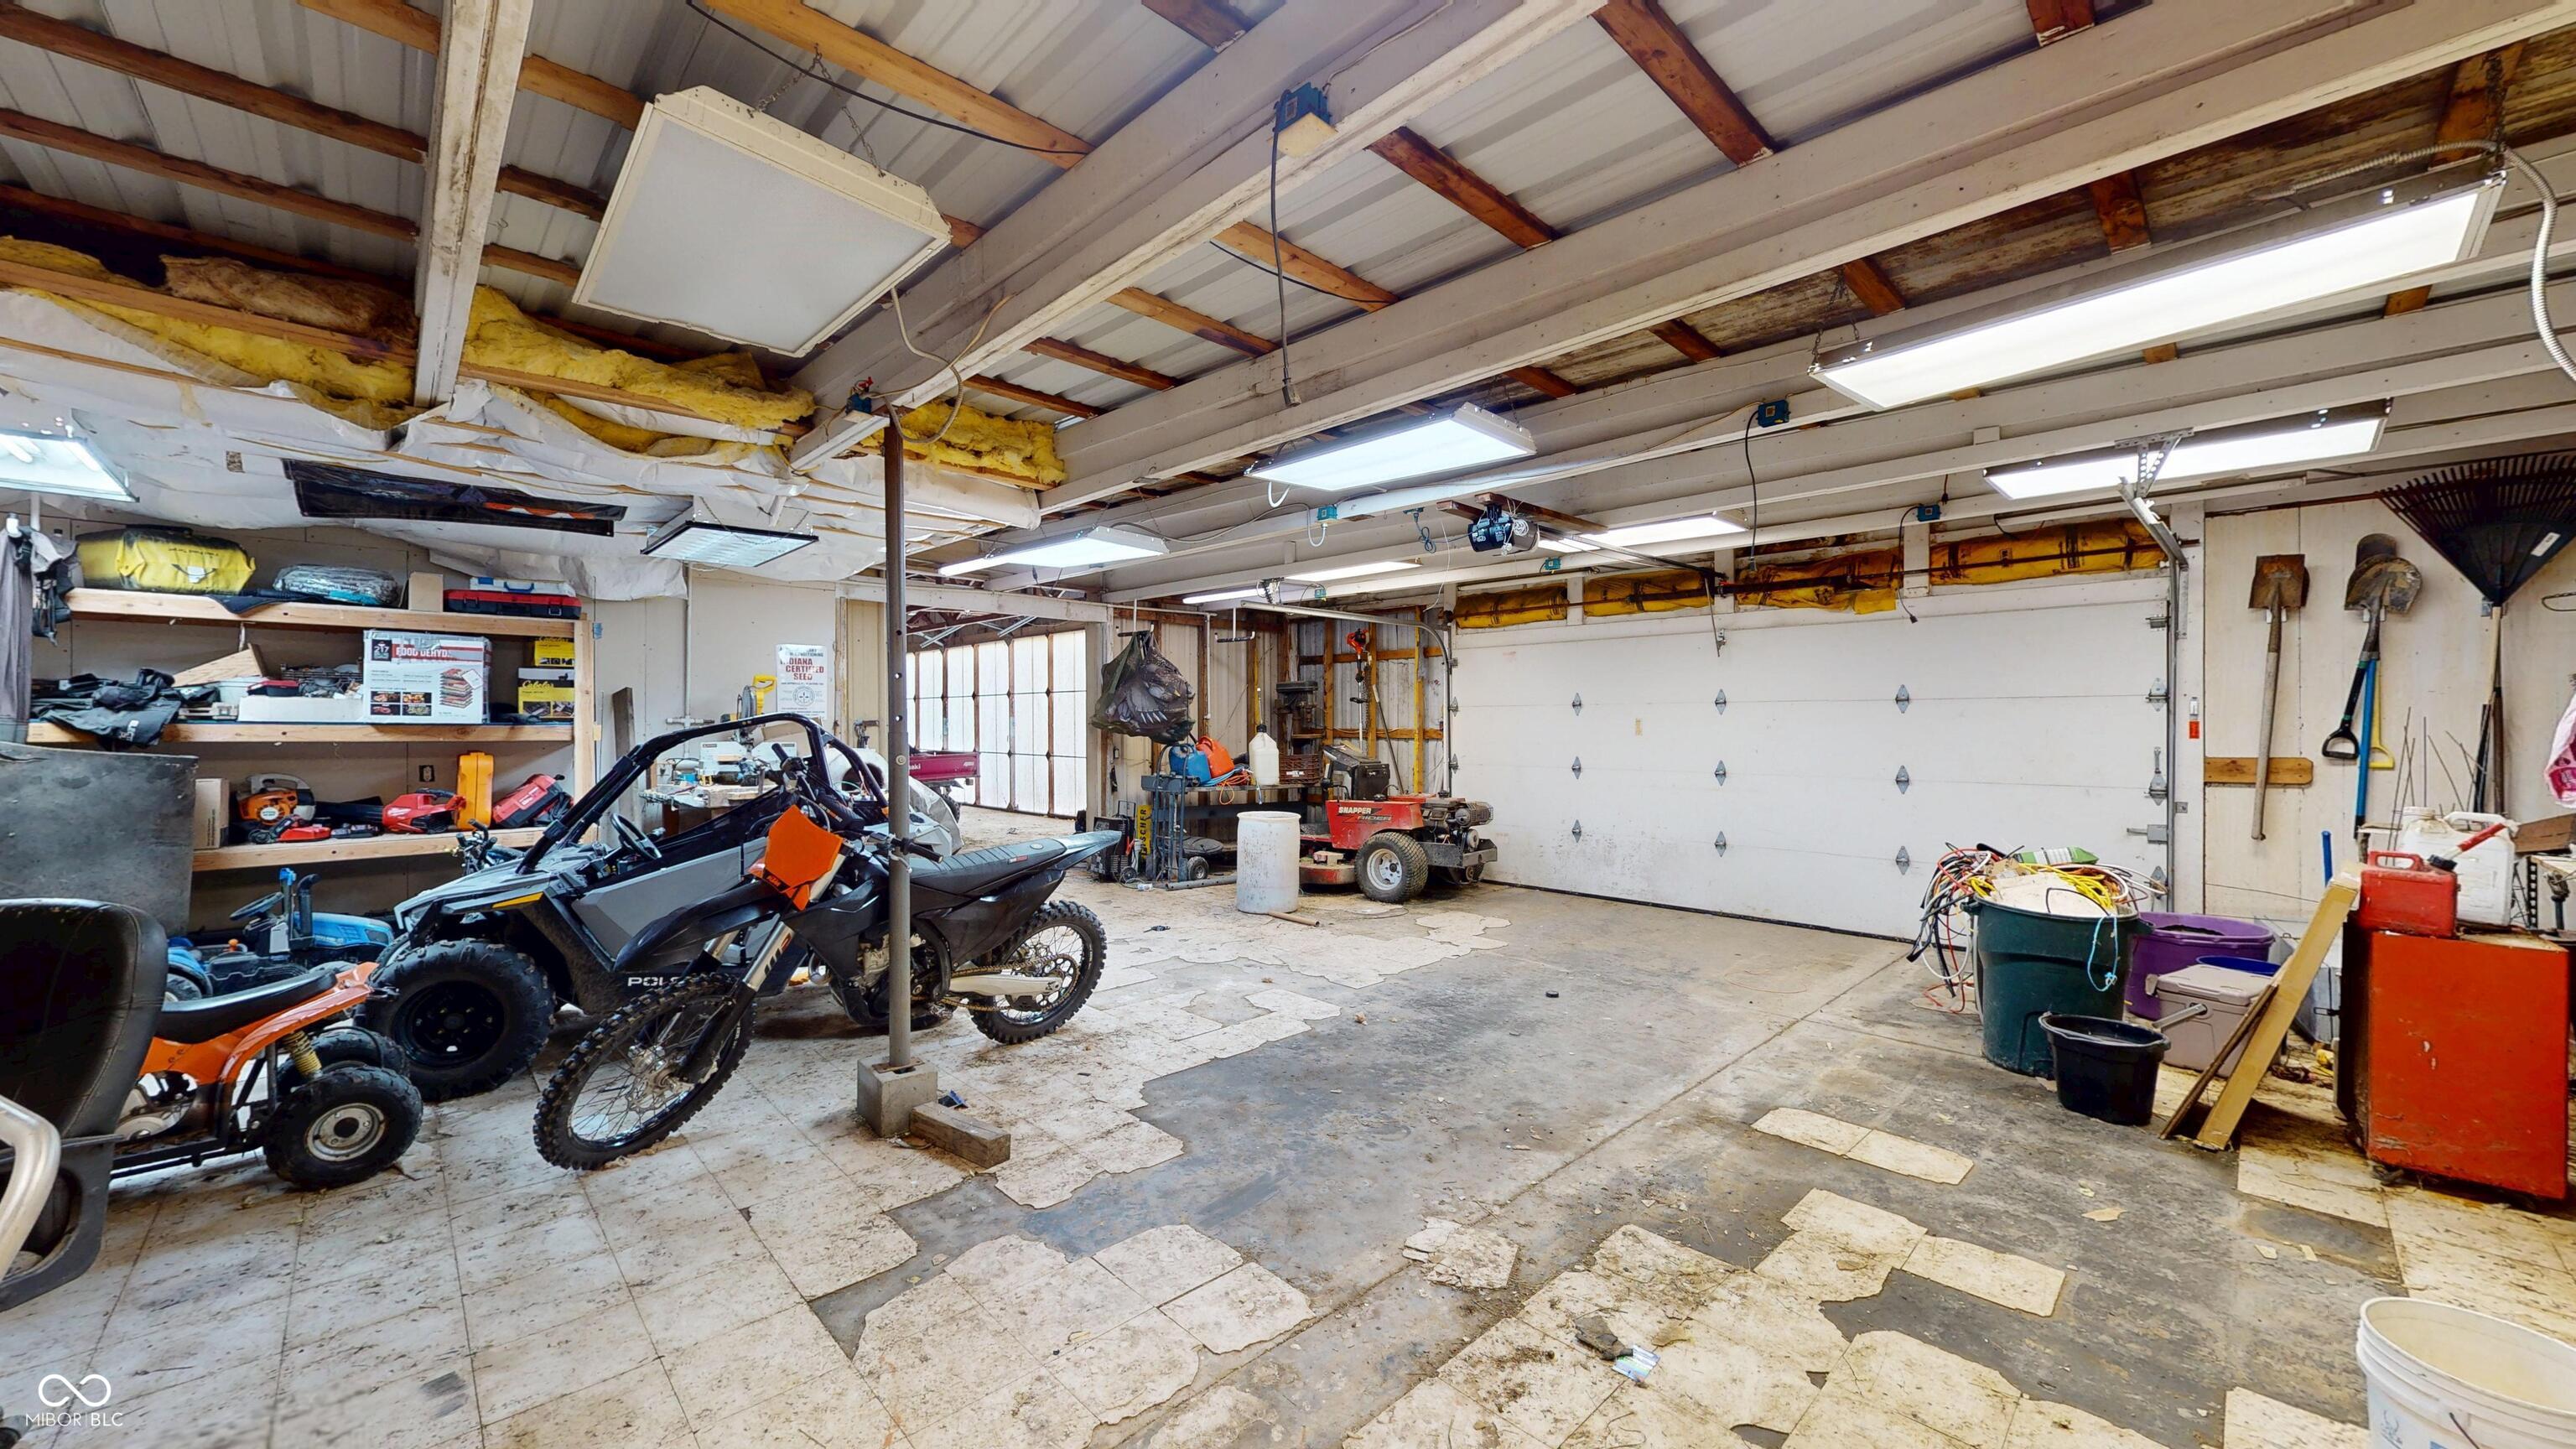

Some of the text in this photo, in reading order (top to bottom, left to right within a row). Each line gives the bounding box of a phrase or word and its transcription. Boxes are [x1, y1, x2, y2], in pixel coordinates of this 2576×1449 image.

[396, 647, 418, 657] FOOD
[420, 648, 450, 657] DEHYD
[786, 665, 824, 673] CERTIFED
